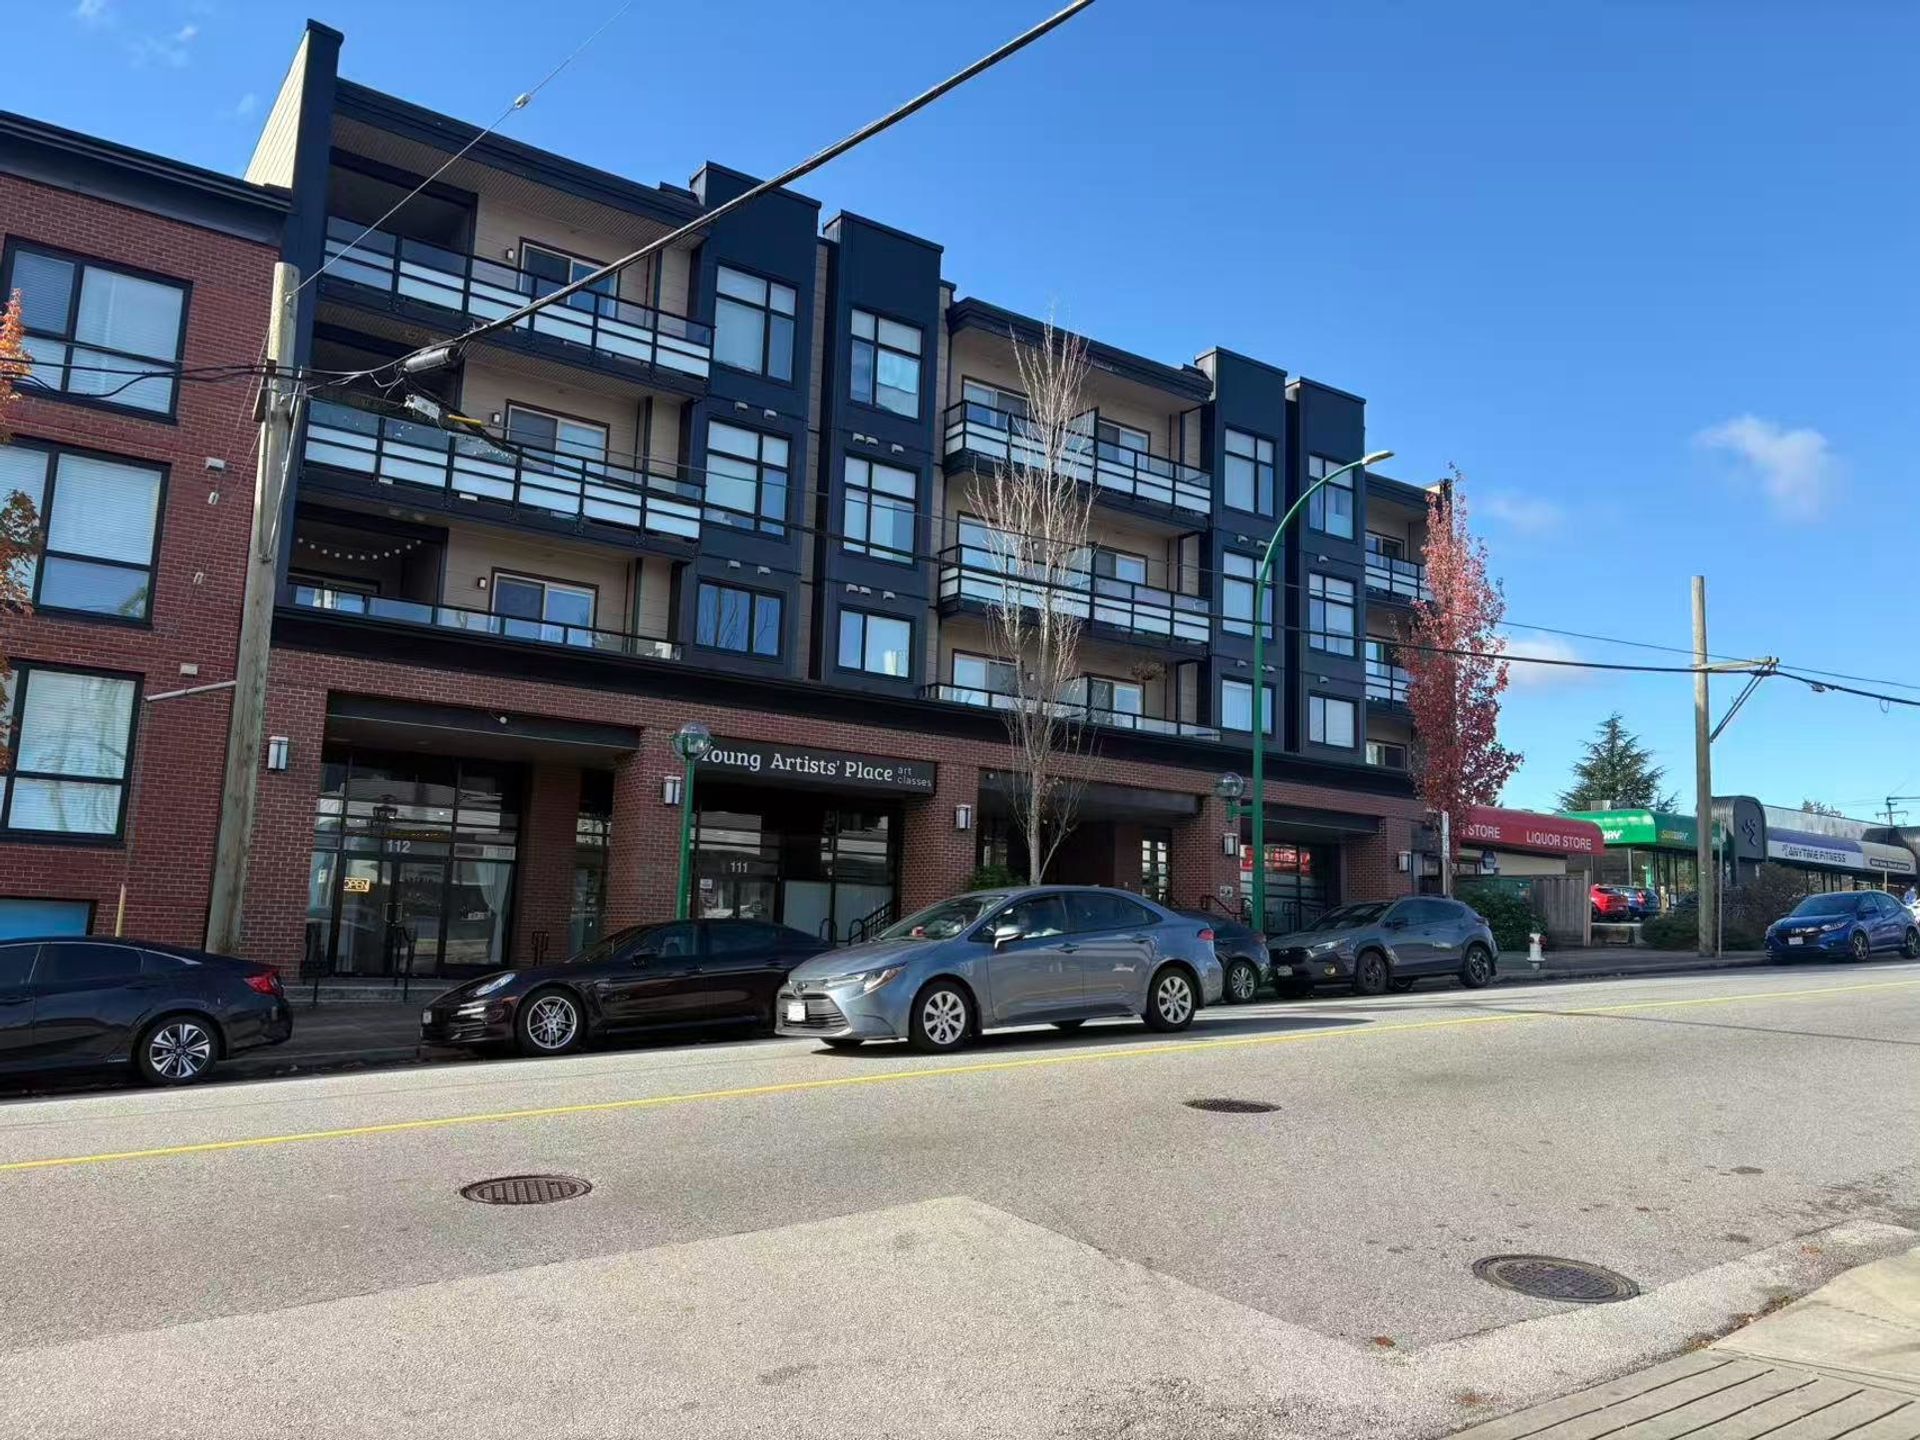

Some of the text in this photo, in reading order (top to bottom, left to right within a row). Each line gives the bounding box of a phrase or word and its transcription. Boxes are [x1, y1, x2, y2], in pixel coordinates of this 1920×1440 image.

[770, 753, 840, 775] Artists'
[844, 761, 893, 781] Place
[897, 767, 912, 776] art
[897, 775, 932, 787] classes
[1468, 823, 1501, 839] STORE
[1526, 830, 1592, 850] LIQUOR STORE
[387, 840, 411, 853] 112
[730, 862, 748, 873] 111
[344, 879, 369, 890] OPEN
